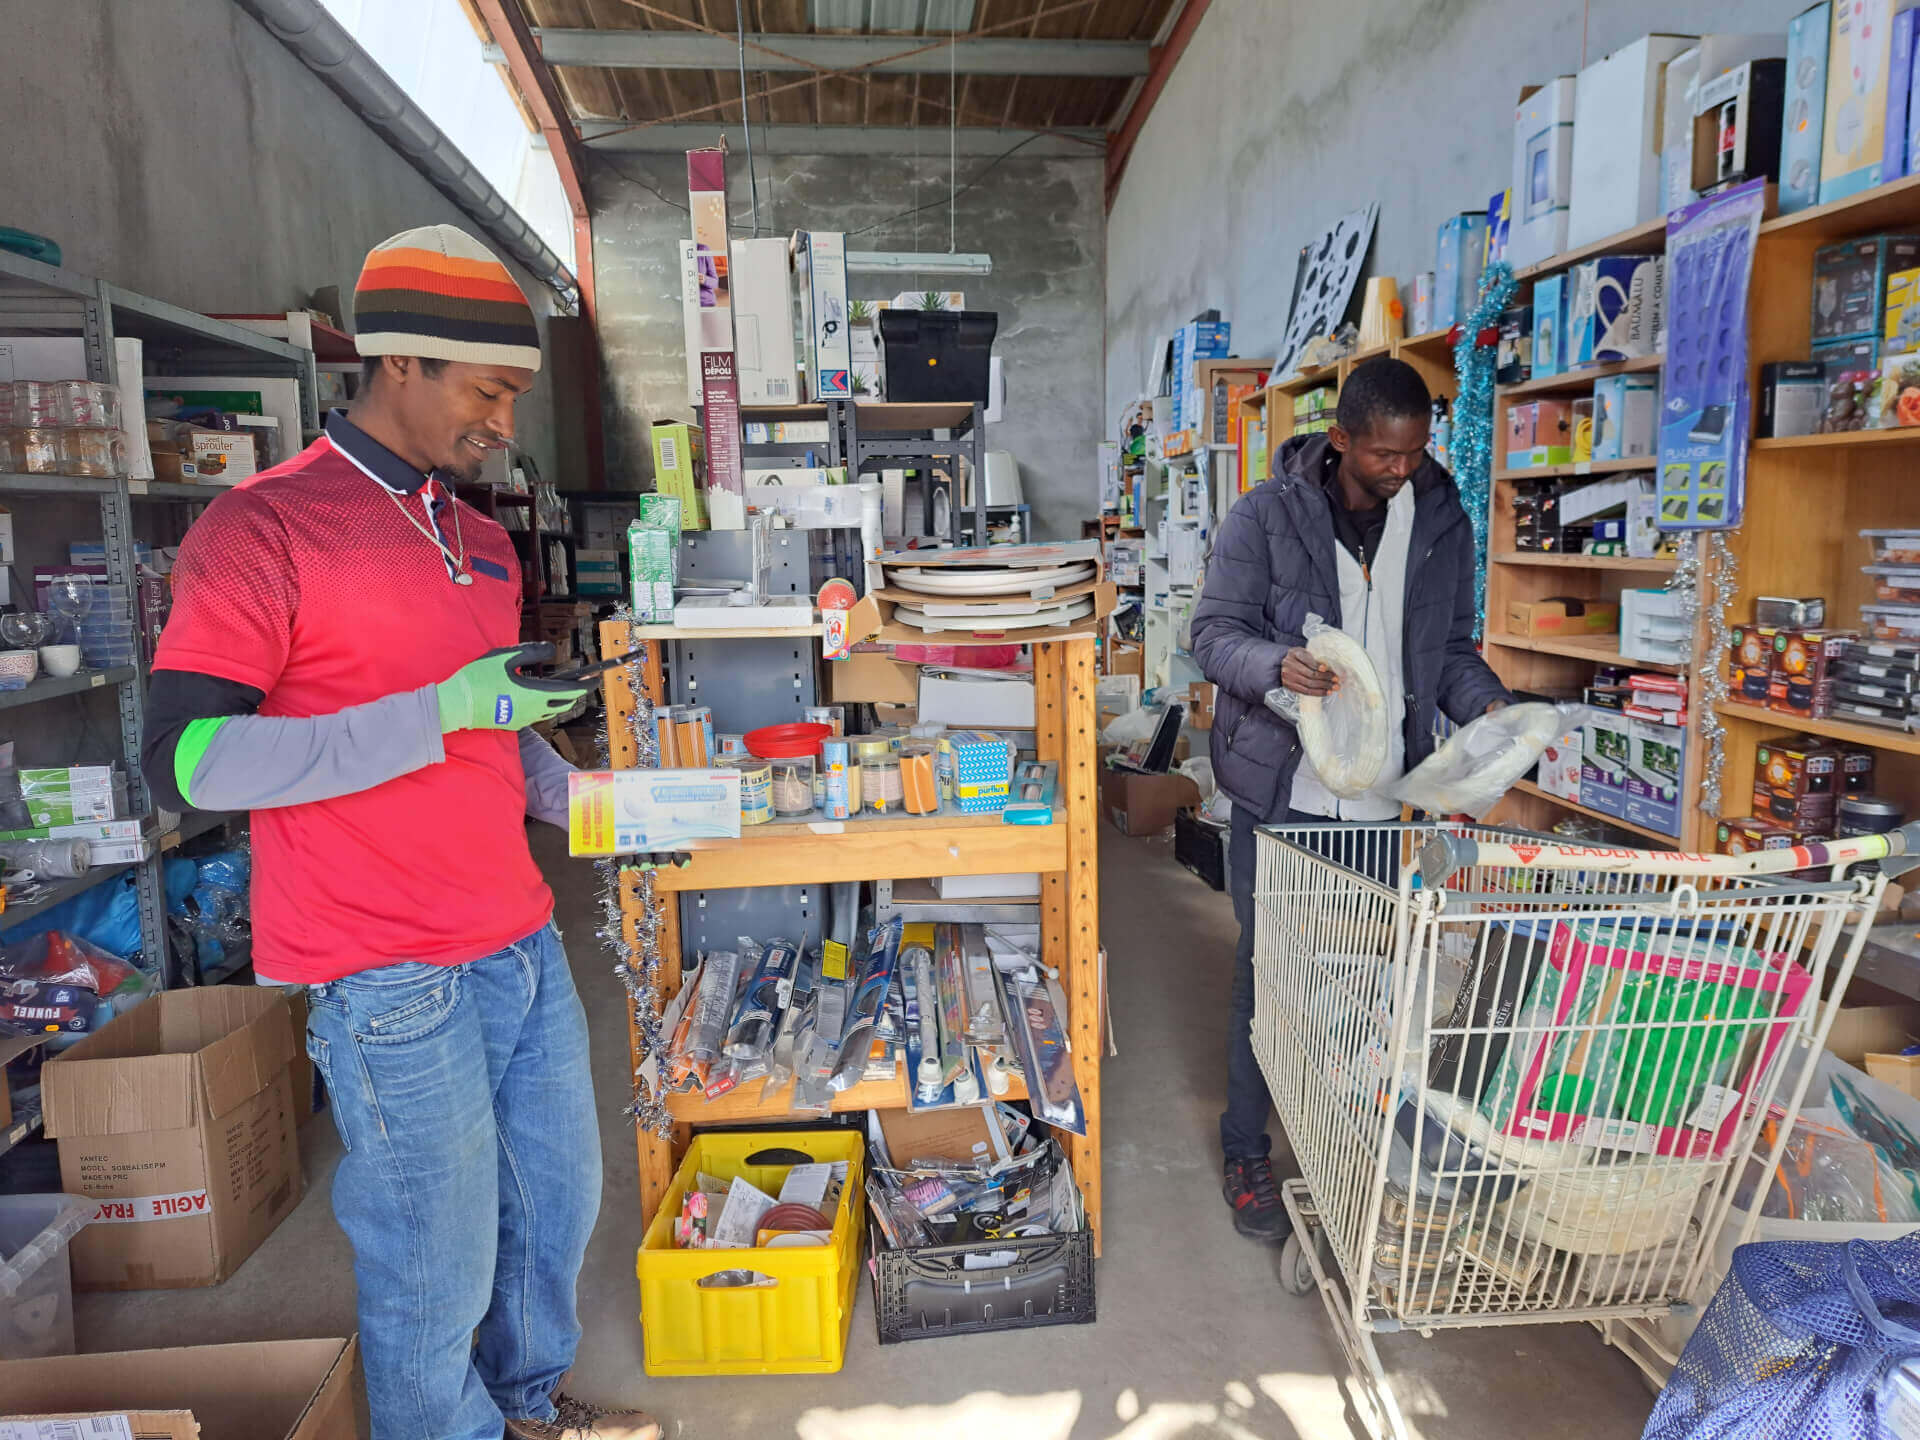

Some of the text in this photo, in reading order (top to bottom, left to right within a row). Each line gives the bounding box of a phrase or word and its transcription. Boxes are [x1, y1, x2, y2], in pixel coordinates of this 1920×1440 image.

[704, 355, 731, 368] FILM
[705, 367, 732, 376] DÉPOLI
[195, 438, 233, 453] sprouter
[977, 783, 1005, 796] purflux
[13, 1006, 61, 1019] FUNNEL
[152, 1193, 207, 1216] AGILE
